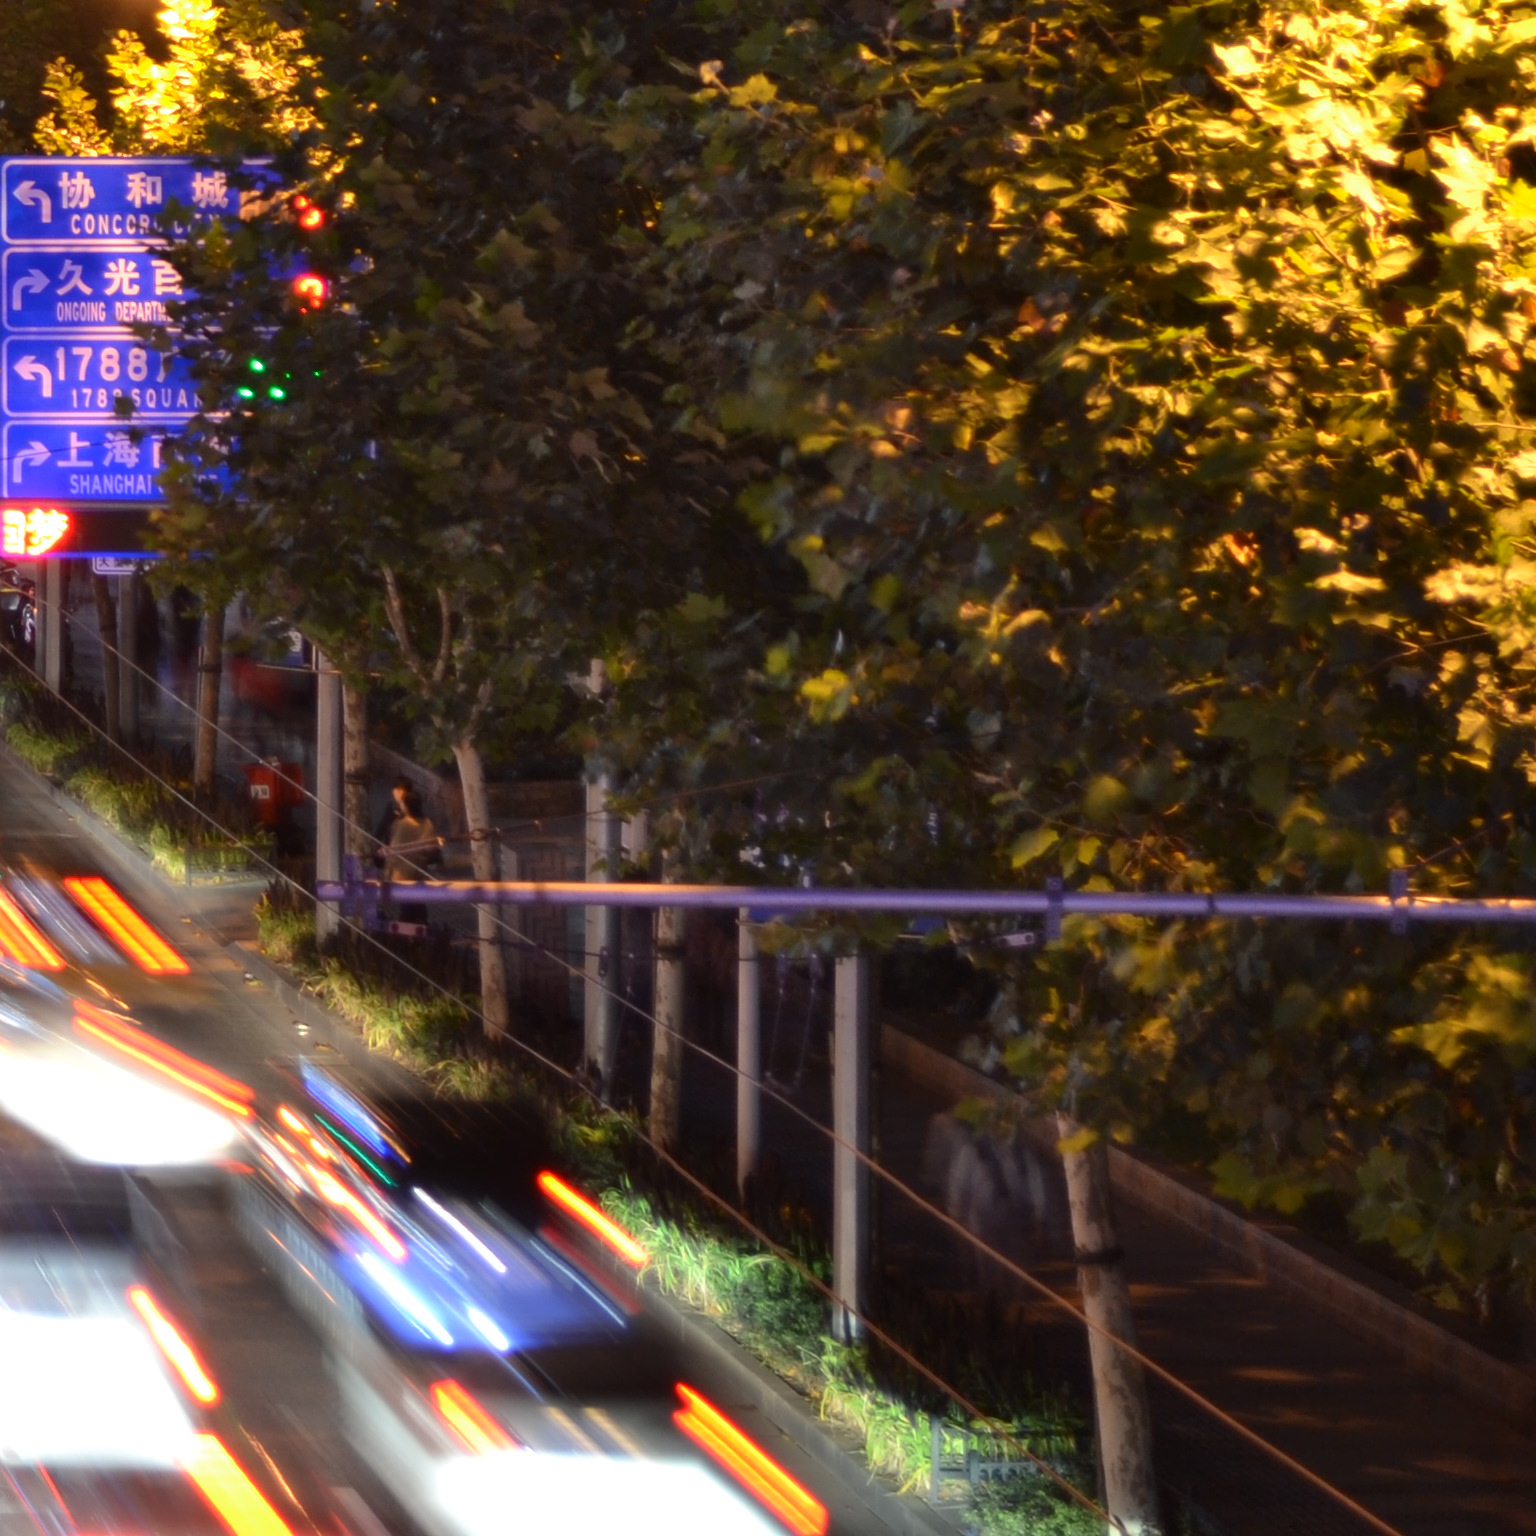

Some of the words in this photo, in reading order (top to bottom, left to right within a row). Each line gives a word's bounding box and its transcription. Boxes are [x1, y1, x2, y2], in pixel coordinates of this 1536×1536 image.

[57, 170, 230, 210] 协和城
[71, 213, 163, 236] CONCOR
[56, 301, 107, 322] ONGOING
[115, 301, 174, 322] DEPARTM
[70, 474, 152, 495] SHANGHAI
